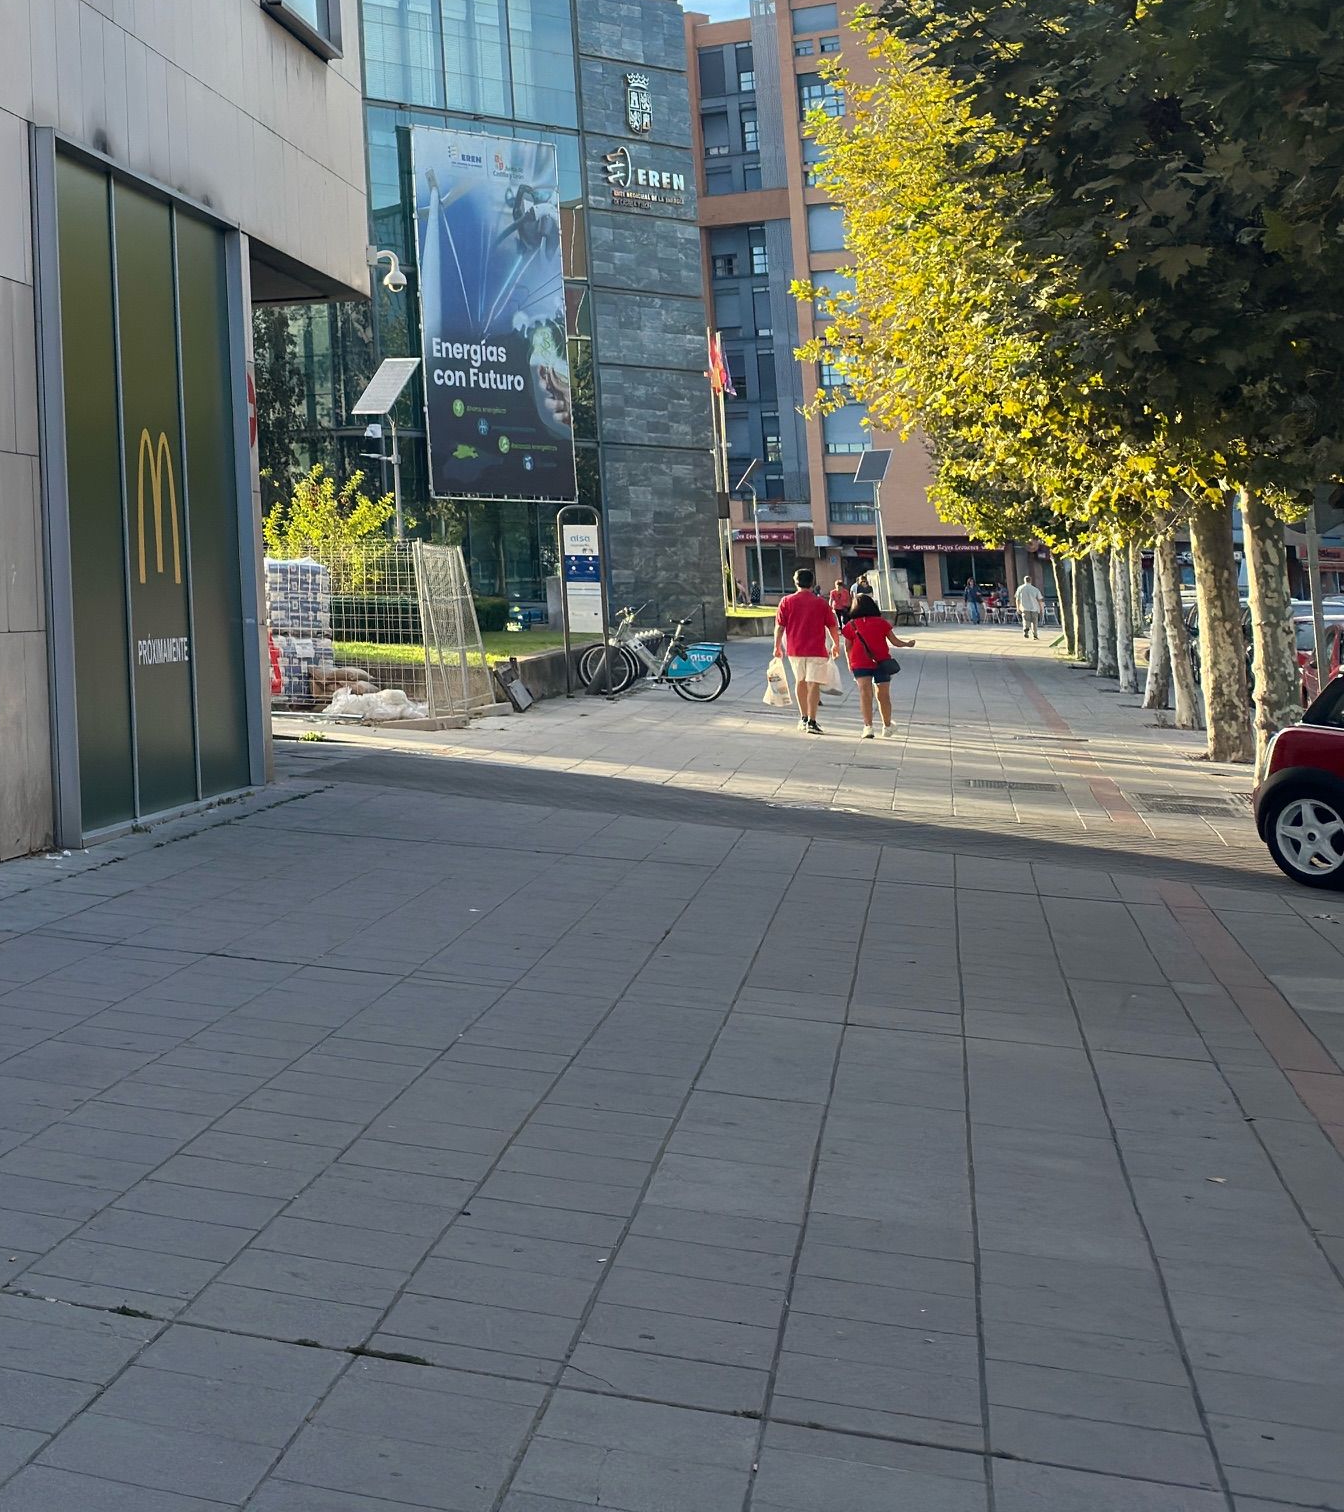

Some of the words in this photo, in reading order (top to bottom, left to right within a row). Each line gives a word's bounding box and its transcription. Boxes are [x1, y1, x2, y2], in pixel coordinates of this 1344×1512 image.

[461, 154, 482, 164] EREN
[637, 168, 686, 191] EREN
[432, 337, 507, 367] Energías
[433, 369, 466, 387] con
[470, 368, 525, 391] Futuro
[570, 534, 591, 543] alsa
[138, 633, 188, 665] PRÓXIMAMENTE
[690, 653, 713, 662] alsa
